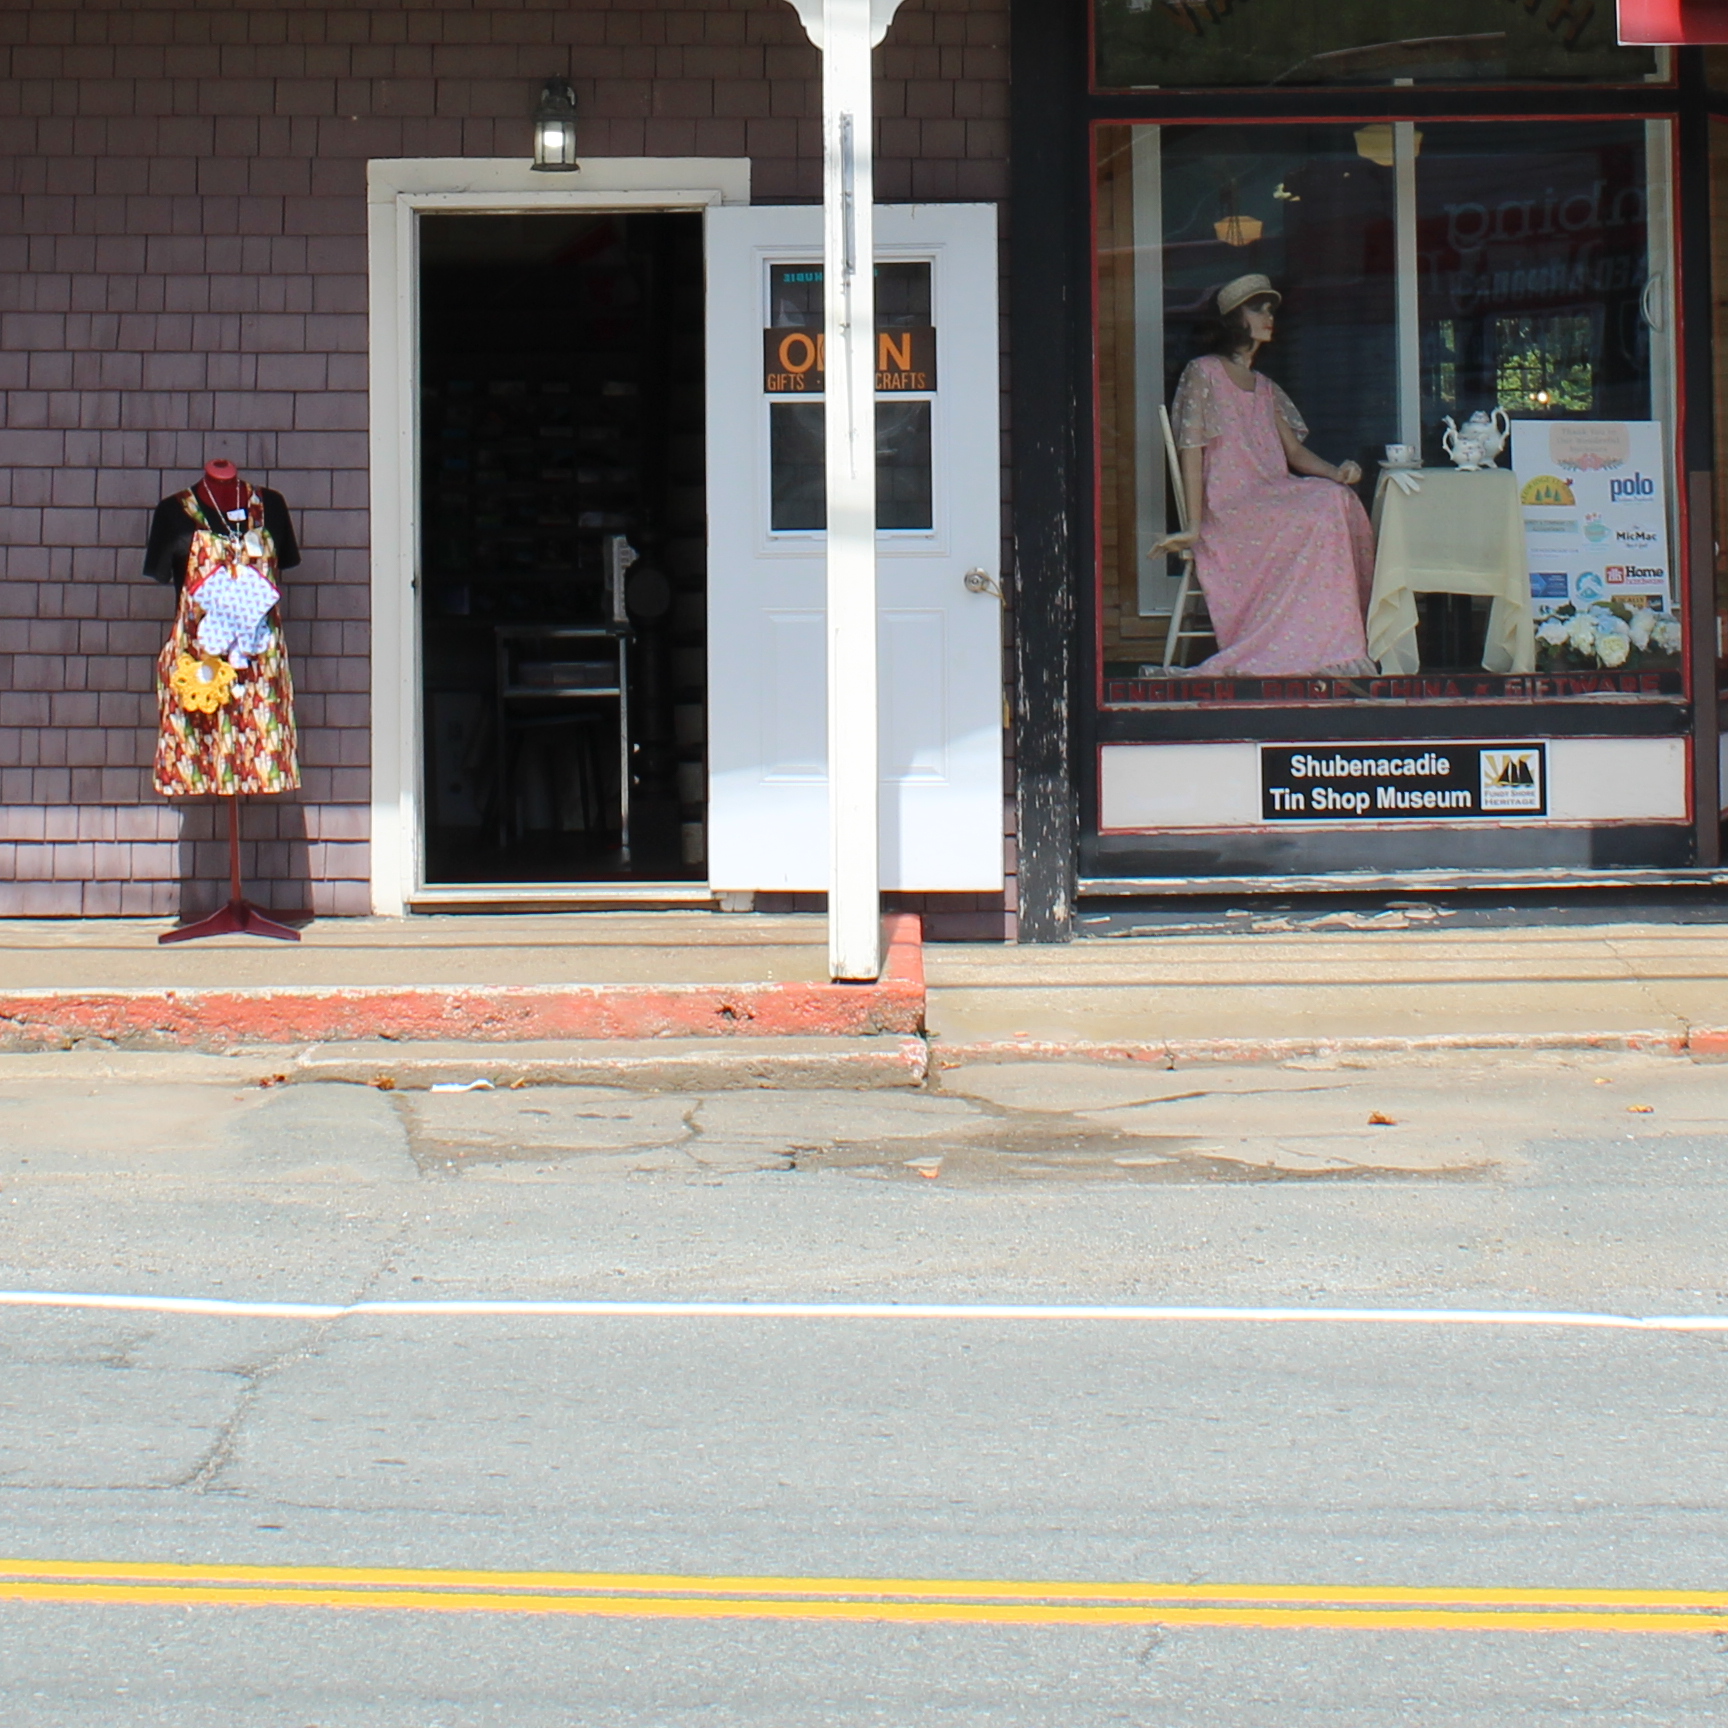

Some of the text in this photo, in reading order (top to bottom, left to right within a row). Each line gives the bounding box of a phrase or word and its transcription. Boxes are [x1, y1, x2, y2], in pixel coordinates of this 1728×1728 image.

[778, 332, 911, 373] ON
[767, 372, 926, 391] GIFTS CRAFTS
[1610, 471, 1654, 502] polo
[1616, 531, 1657, 541] MicMac
[1625, 565, 1664, 578] Home
[1109, 674, 1660, 703] ENGLISH BONE CHINA GIFTWARE
[1290, 754, 1451, 777] Shubenacadie
[1270, 786, 1472, 814] Tin Shop Museum
[1484, 798, 1536, 806] HERITAGE
